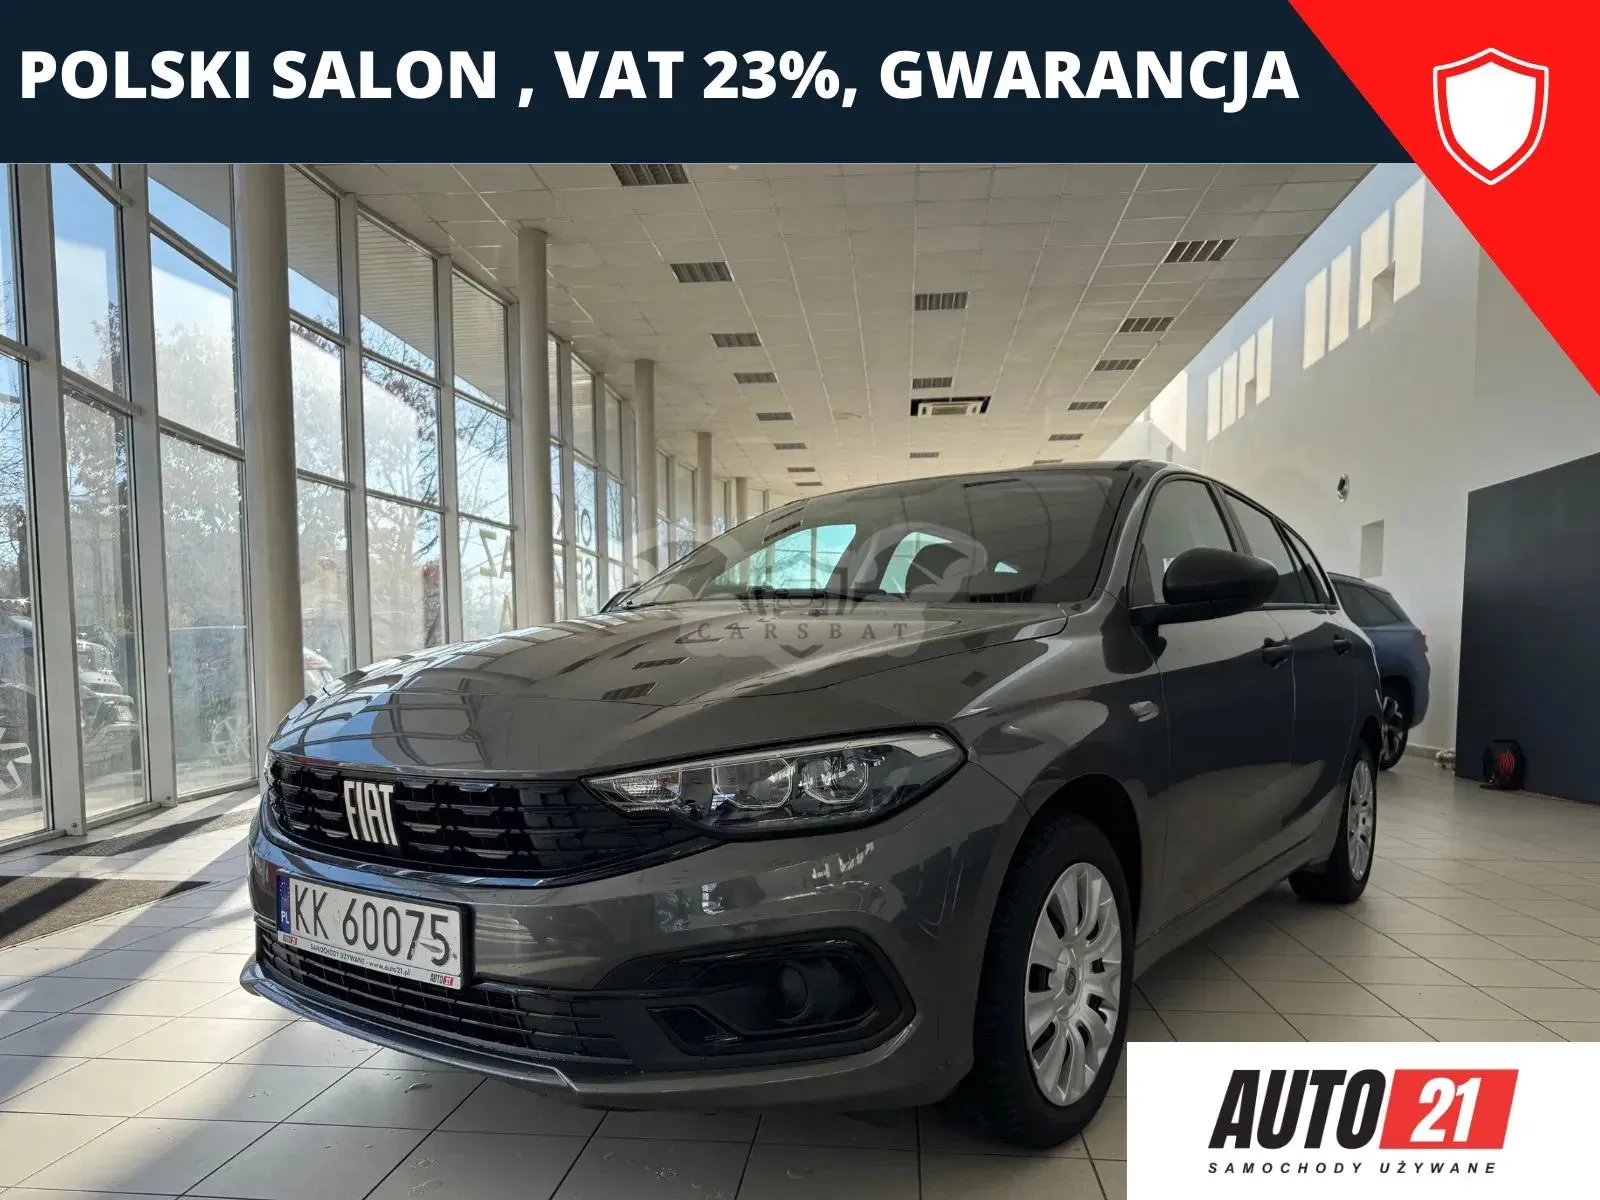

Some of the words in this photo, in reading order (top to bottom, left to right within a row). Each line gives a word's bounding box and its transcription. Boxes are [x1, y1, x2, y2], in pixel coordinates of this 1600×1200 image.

[343, 780, 399, 846] FIAT
[294, 884, 329, 941] KK
[342, 898, 450, 967] 60075
